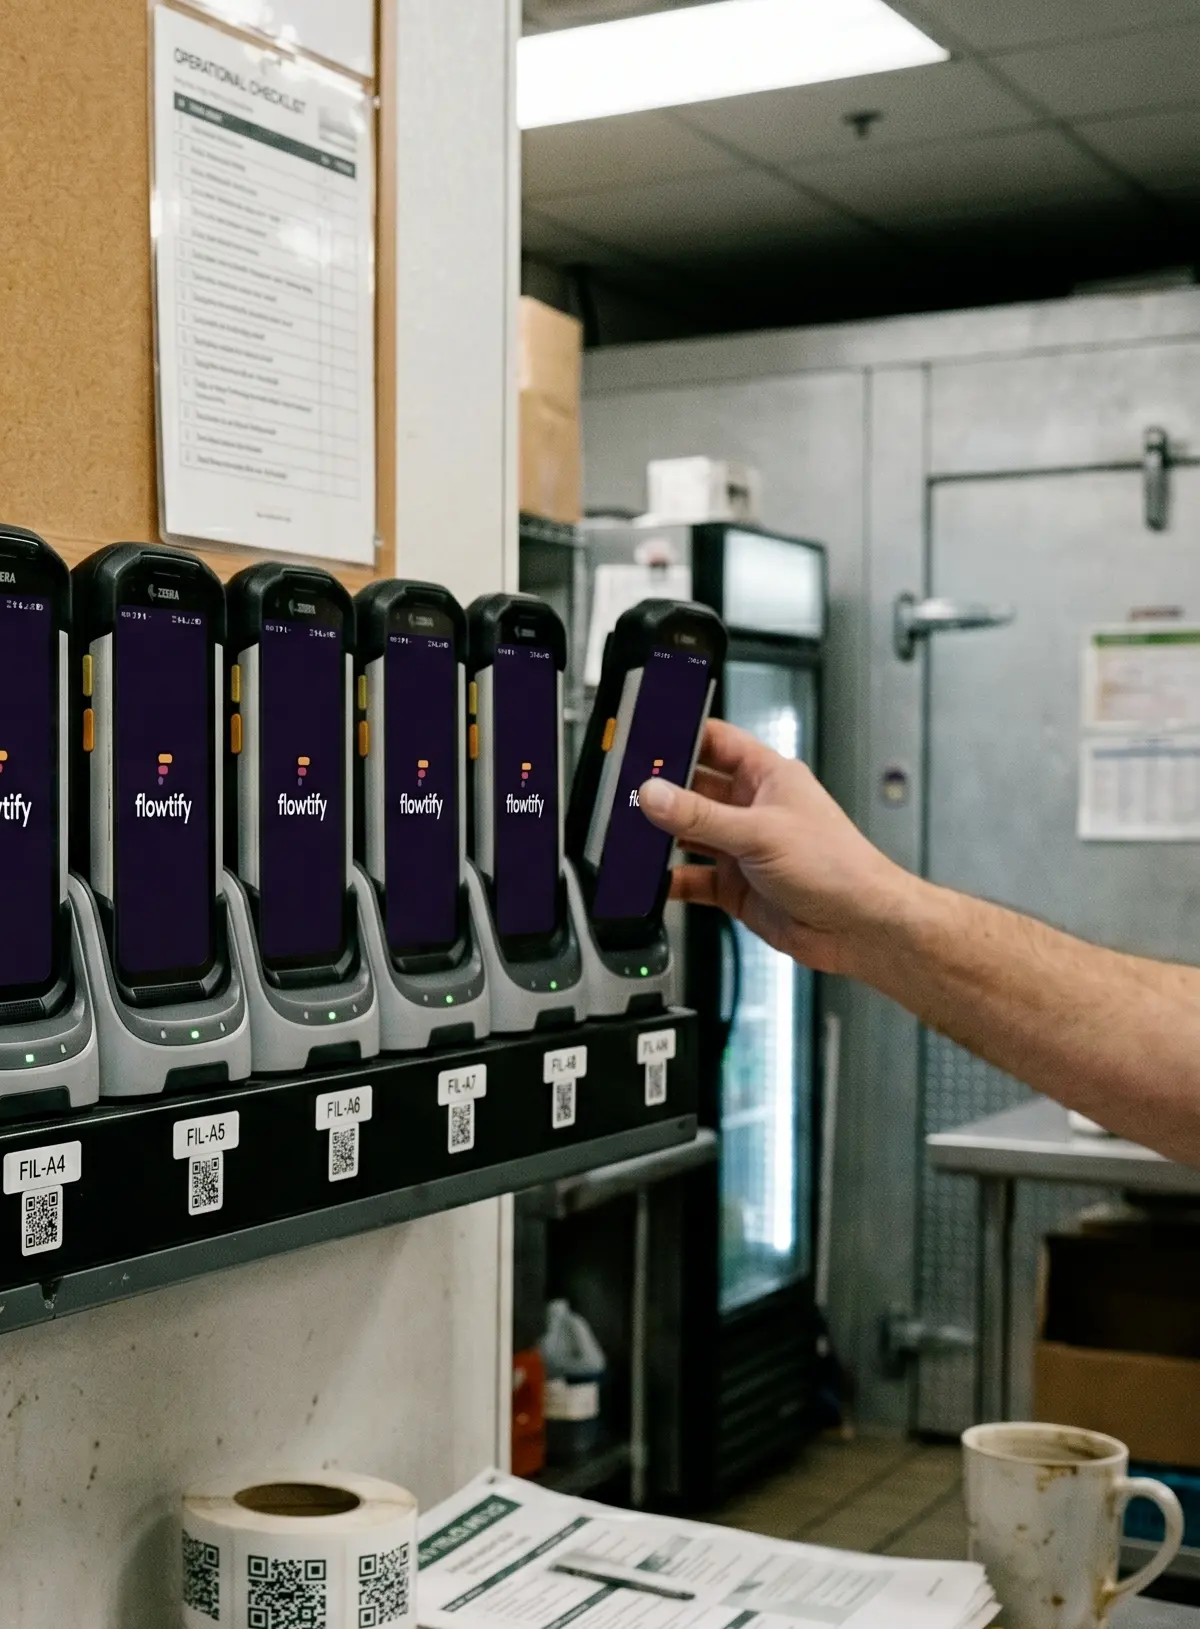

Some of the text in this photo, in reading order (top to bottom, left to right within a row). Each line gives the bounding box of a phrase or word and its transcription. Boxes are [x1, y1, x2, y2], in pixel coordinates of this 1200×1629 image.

[135, 792, 192, 824] flowtify
[277, 792, 328, 822] flowtify
[399, 792, 444, 820] flowtify
[505, 793, 545, 819] flowtify
[327, 1096, 361, 1119] FIL-A6
[187, 1122, 226, 1148] FIL-A5
[19, 1153, 67, 1181] FIL-A4
